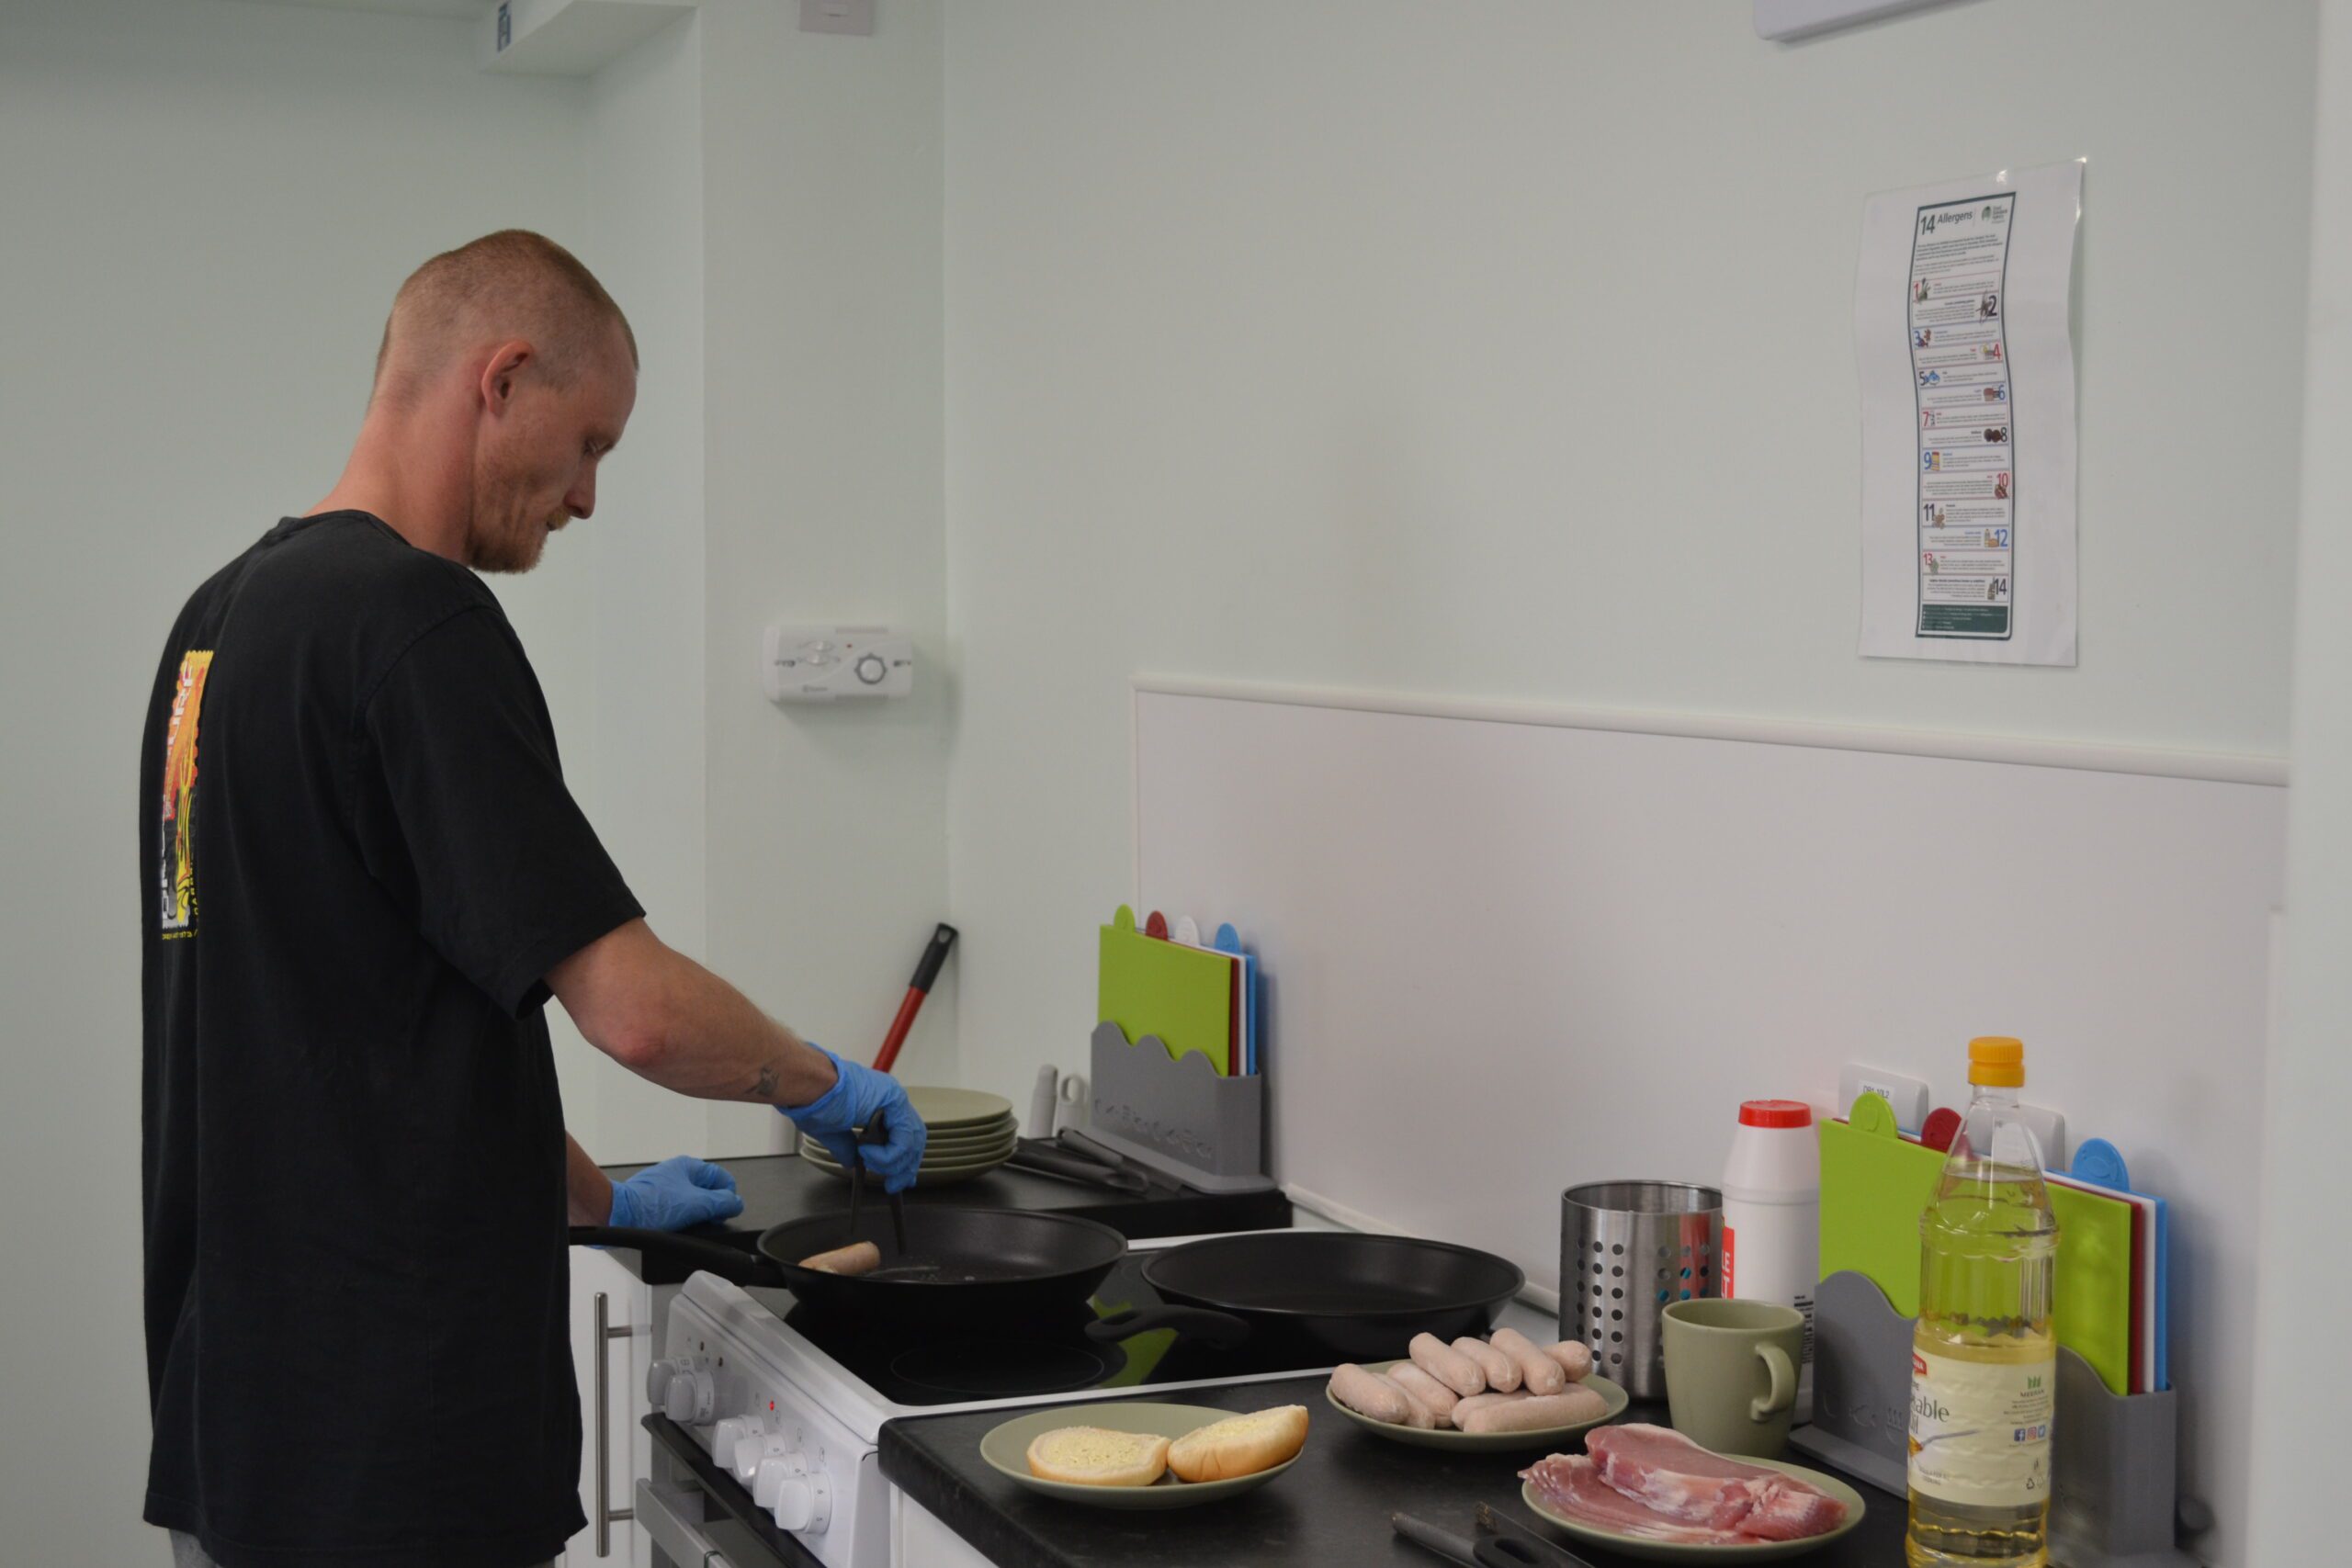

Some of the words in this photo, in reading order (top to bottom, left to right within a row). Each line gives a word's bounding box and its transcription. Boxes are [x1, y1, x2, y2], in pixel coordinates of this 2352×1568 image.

[1920, 214, 1936, 235] 14
[1937, 210, 1973, 224] Allergens
[1987, 294, 1997, 317] 2
[1993, 343, 2001, 360] 4
[1919, 370, 1926, 386] 5
[1997, 385, 2006, 400] 6
[1922, 411, 1929, 427] 7
[2000, 427, 2007, 442] 8
[1924, 451, 1932, 470] 9
[1997, 472, 2008, 489] 10
[1923, 503, 1935, 522] 11
[1994, 529, 2008, 547] 12
[1923, 553, 1933, 566] 13
[1994, 578, 2007, 595] 14
